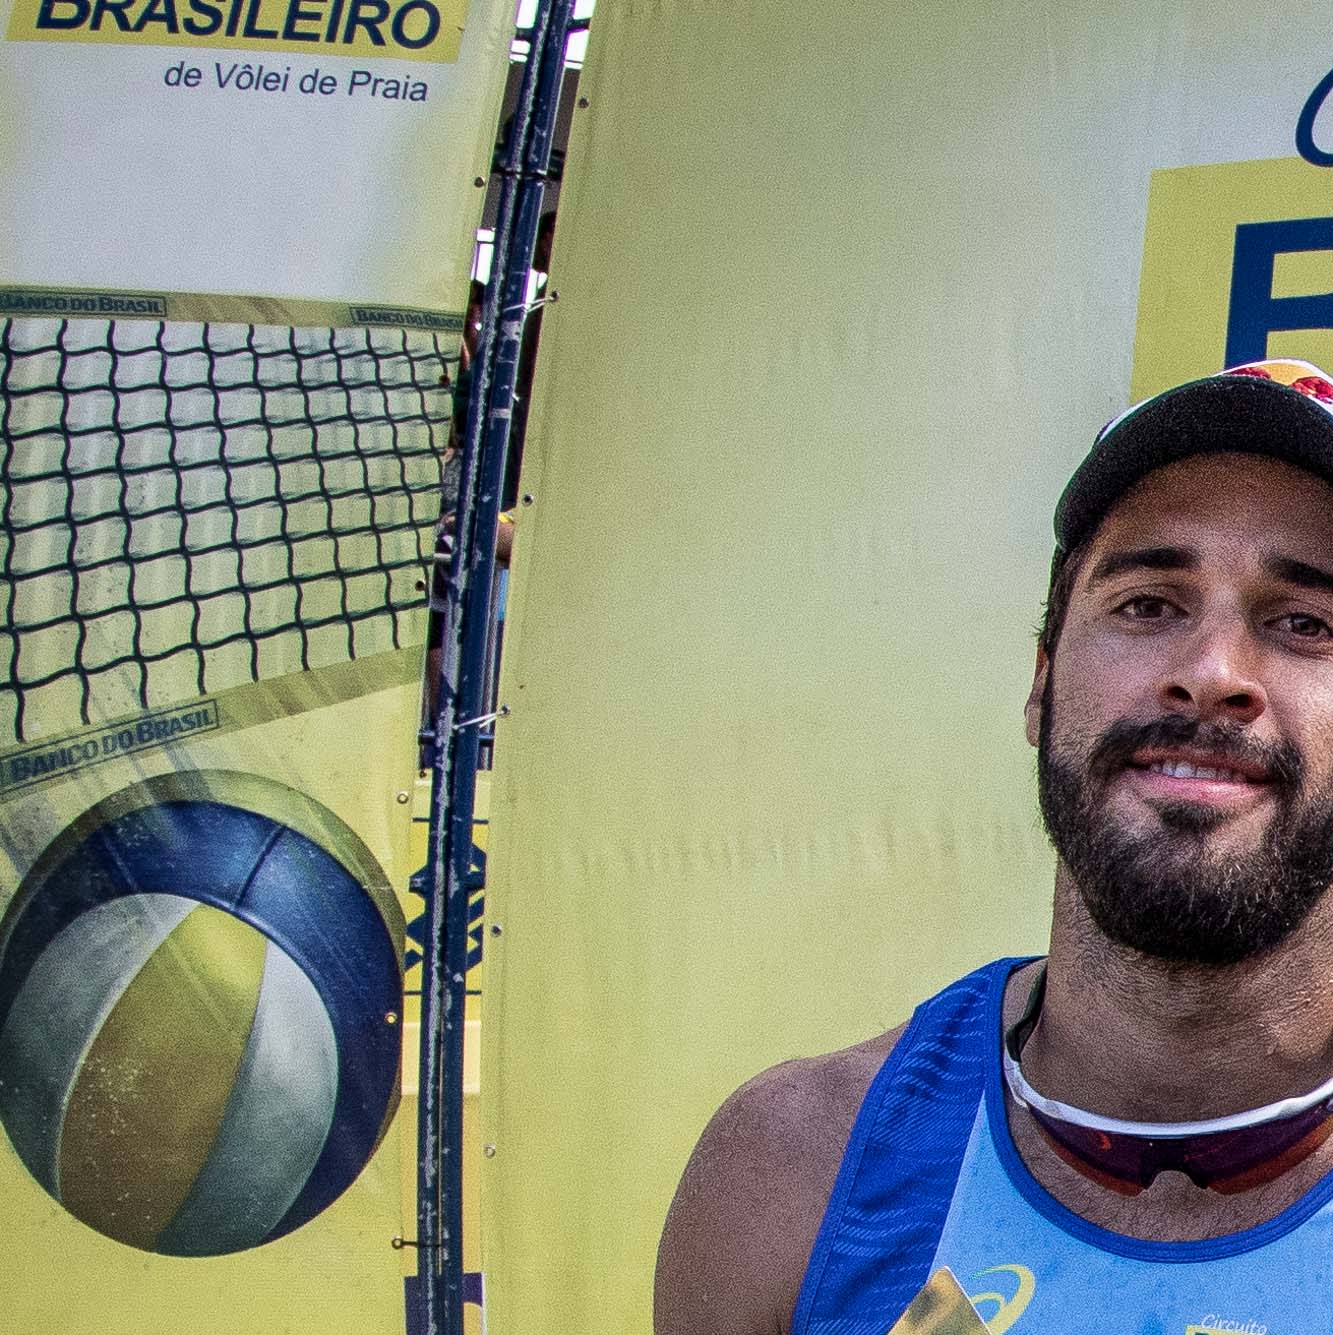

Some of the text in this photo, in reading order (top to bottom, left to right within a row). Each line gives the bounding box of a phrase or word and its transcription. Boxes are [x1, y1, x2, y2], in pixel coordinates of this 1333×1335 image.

[164, 61, 430, 101] de Vôlei de Praia
[10, 740, 99, 782] BANCO
[136, 708, 213, 745] BRASIL
[1201, 1313, 1268, 1335] Circuito
